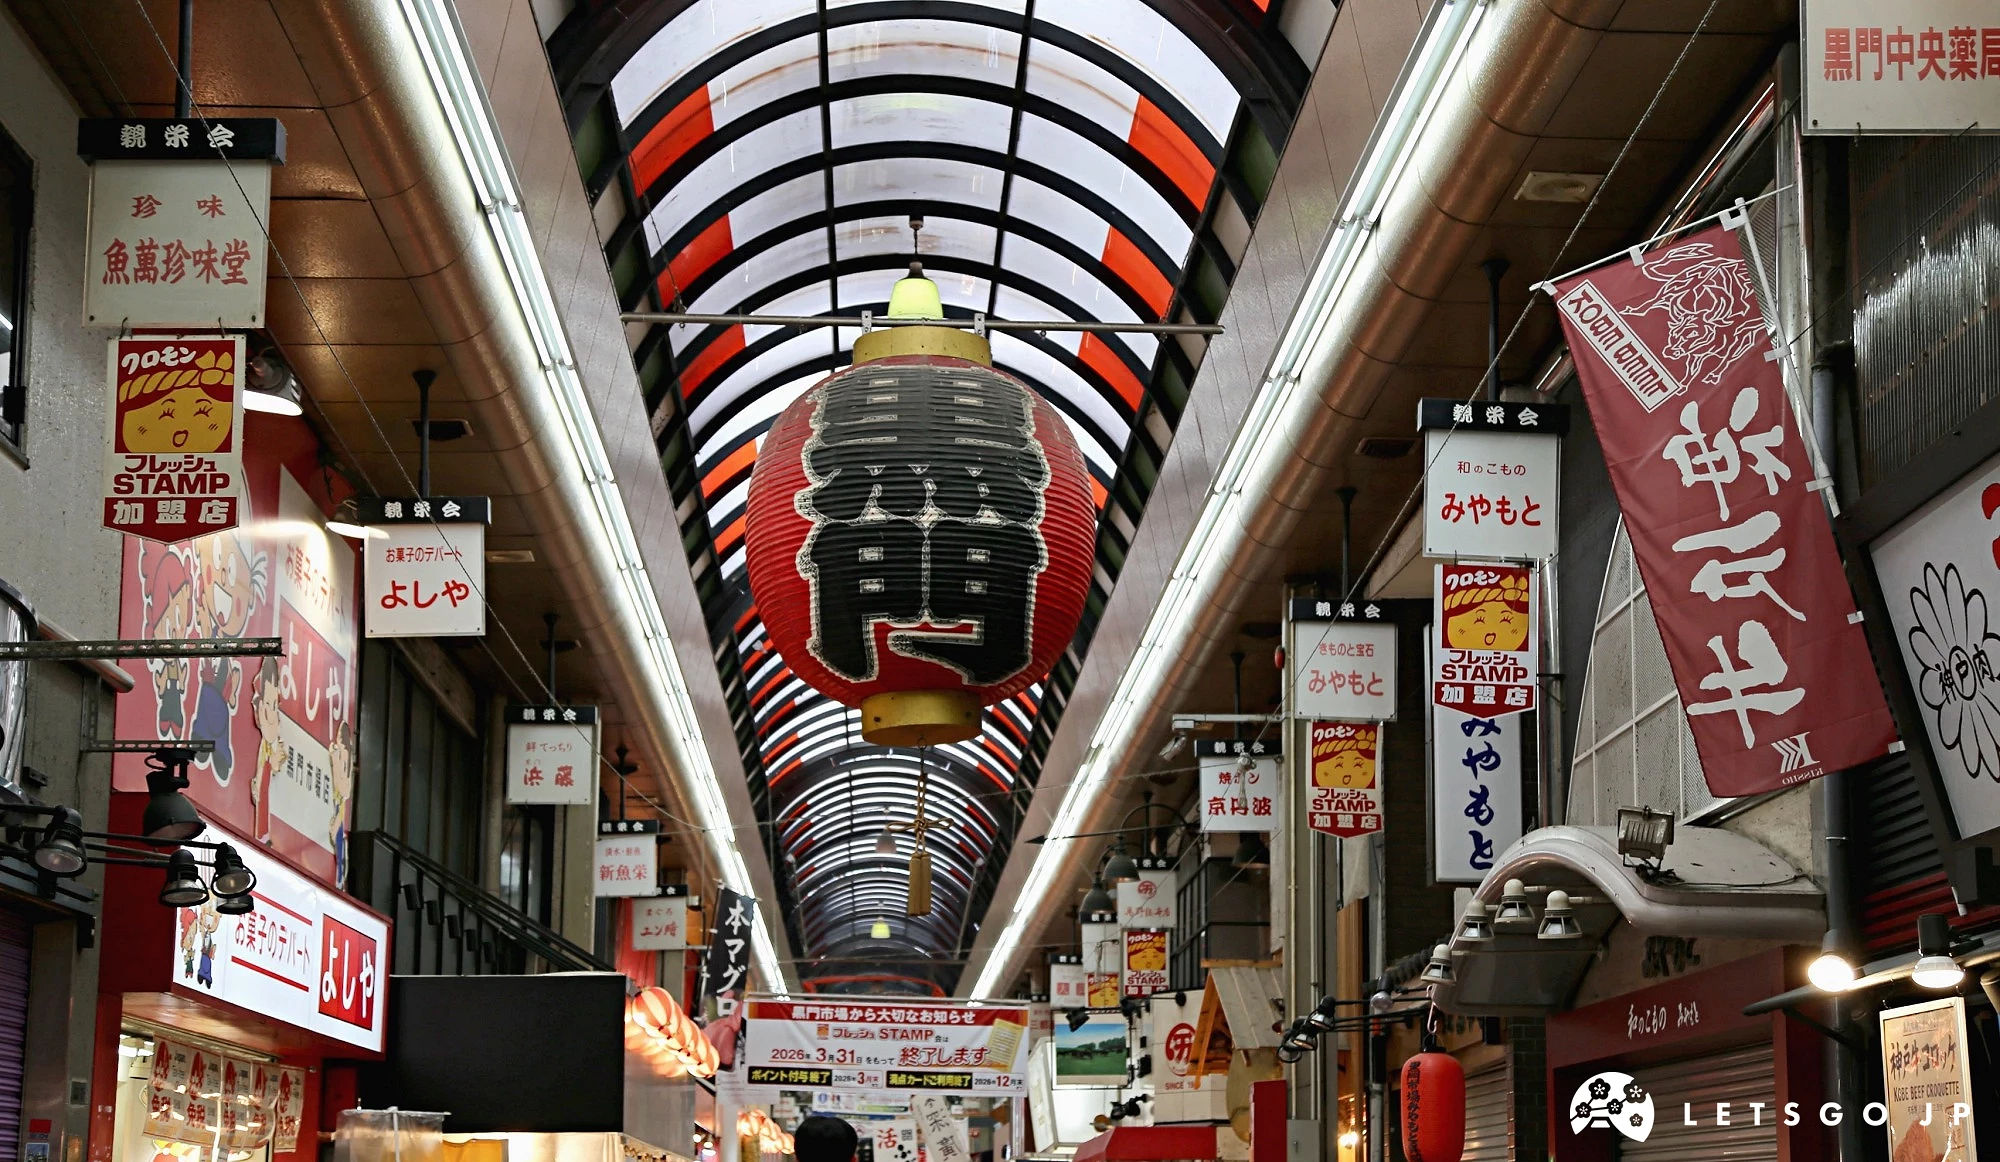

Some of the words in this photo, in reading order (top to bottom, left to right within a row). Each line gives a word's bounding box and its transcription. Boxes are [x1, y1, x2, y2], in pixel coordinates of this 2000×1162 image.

[1823, 26, 2000, 81] 黒門中央薬局
[121, 124, 235, 148] 親栄会
[102, 237, 251, 285] 魚萬珍味堂
[121, 346, 197, 375] クロモン
[1452, 403, 1539, 426] 親栄会
[125, 455, 217, 473] フレッシュ
[1457, 460, 1527, 476] 和のこもの
[113, 473, 230, 495] STAMP
[113, 500, 230, 525] 加盟店
[384, 500, 461, 519] 親栄会
[1441, 492, 1541, 527] みやもと
[794, 364, 1051, 686] 黒門
[385, 546, 463, 563] お菓子のデパート
[1445, 571, 1502, 591] クロモン
[380, 579, 470, 609] よしや
[1315, 601, 1381, 619] 親栄会
[1449, 650, 1519, 666] フレッシュ
[1308, 669, 1384, 697] みやもと
[1441, 664, 1529, 683] STAMP
[1441, 684, 1528, 706] 加盟店
[1313, 726, 1356, 742] クロモン
[1317, 788, 1369, 800] フレッシュ
[1208, 796, 1272, 816] 京丹波
[1312, 799, 1377, 813] STAMP
[1313, 813, 1377, 830] 加盟店
[234, 910, 312, 976] お菓子のデパート
[716, 899, 751, 1016] 本マグロ
[322, 930, 375, 1019] よしや
[1128, 977, 1166, 985] STAMP
[791, 1005, 976, 1024] 黒門市場から大切なお知らせ
[1910, 1084, 1925, 1100] BEEF
[1926, 1080, 1960, 1098] CROQUETTE
